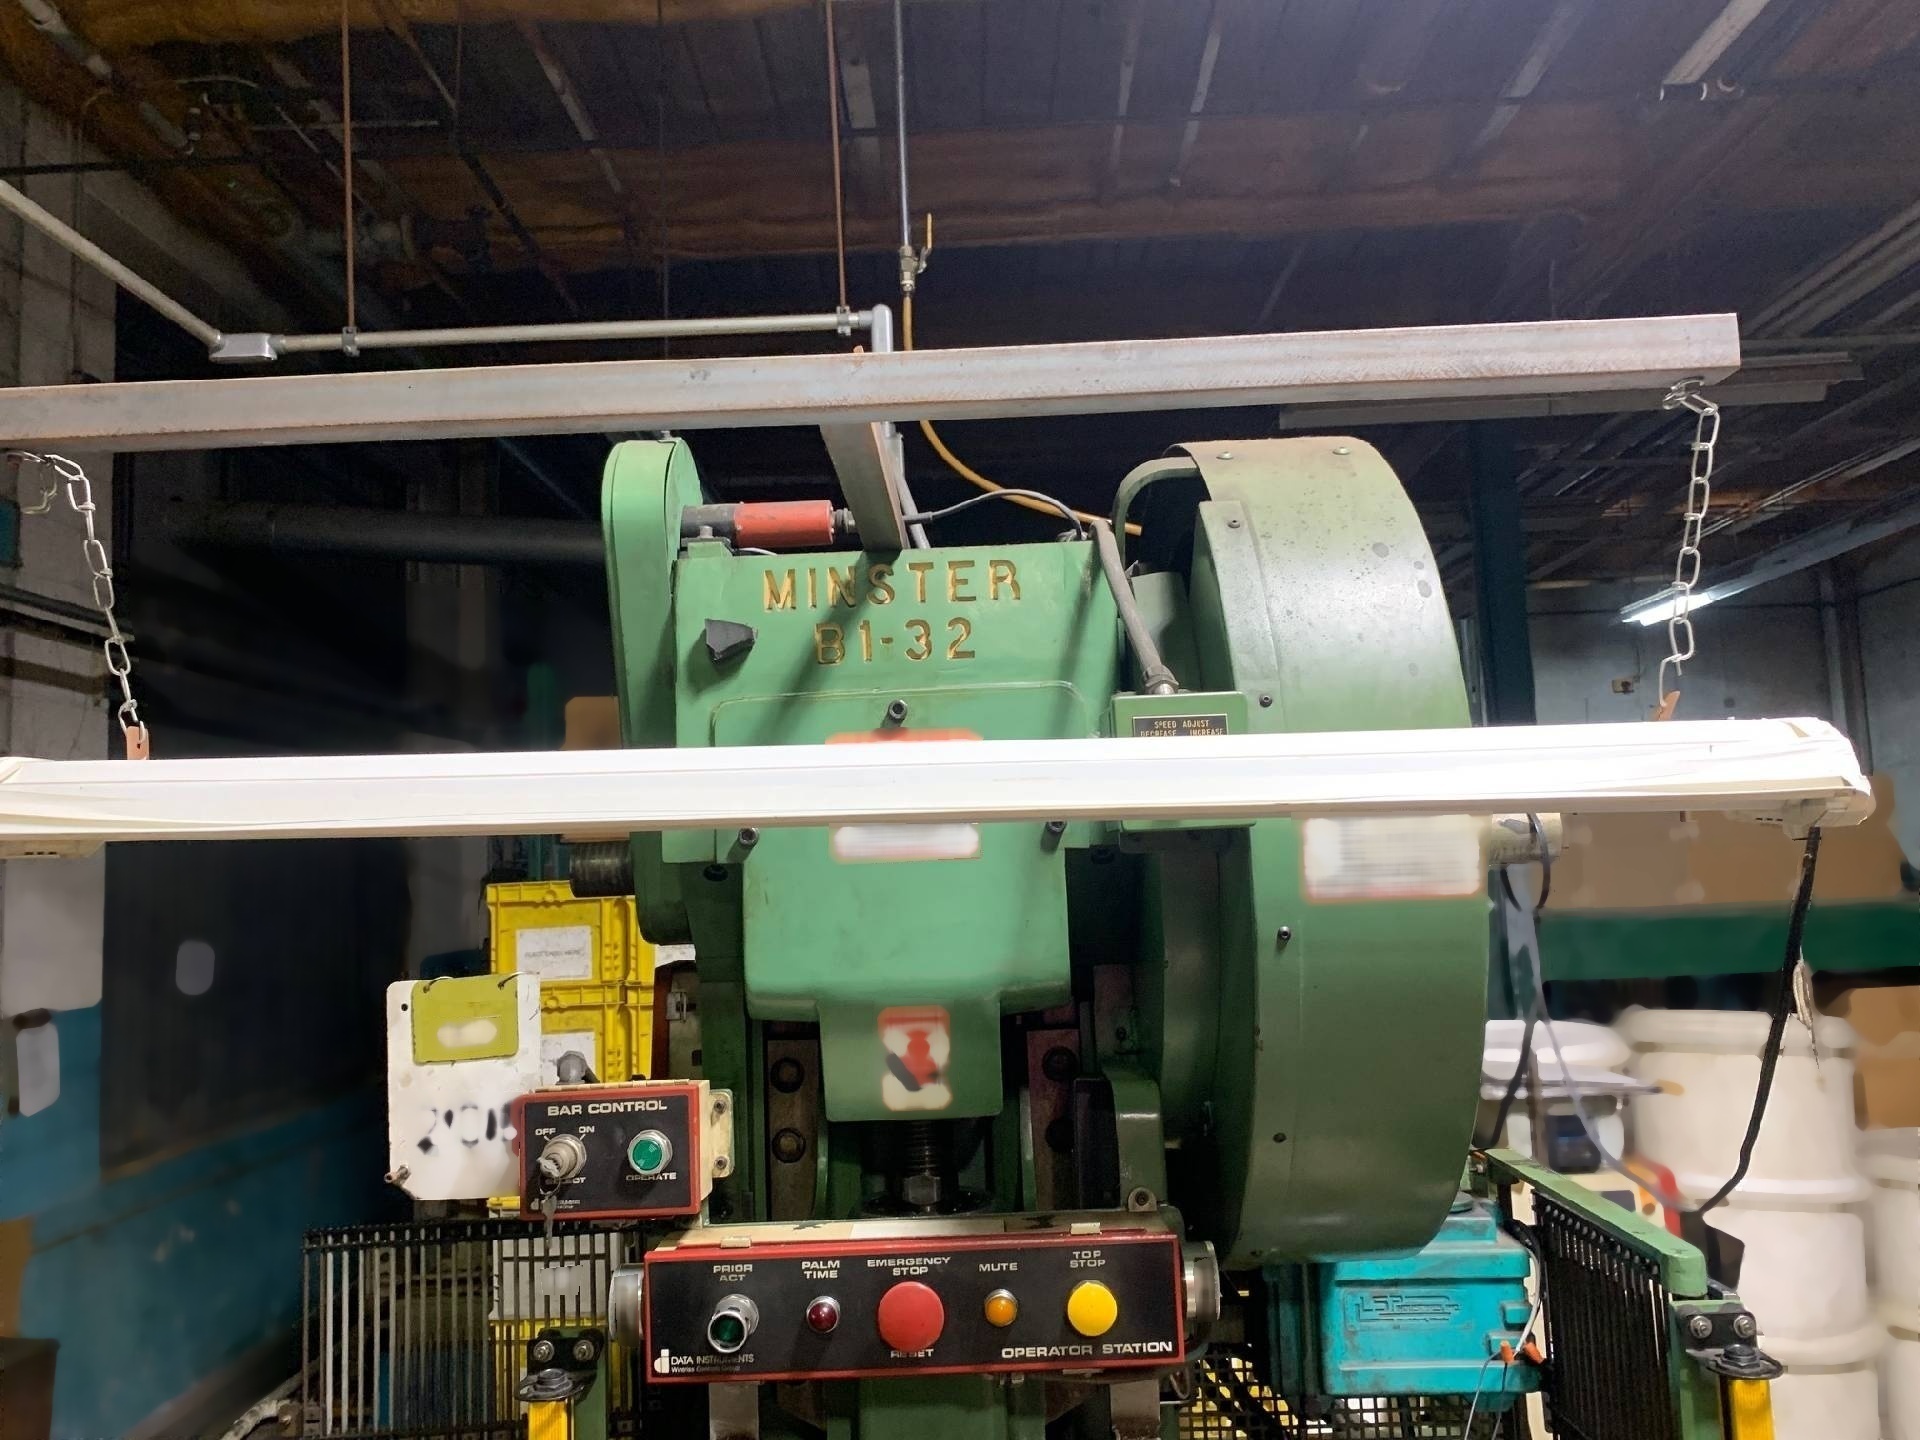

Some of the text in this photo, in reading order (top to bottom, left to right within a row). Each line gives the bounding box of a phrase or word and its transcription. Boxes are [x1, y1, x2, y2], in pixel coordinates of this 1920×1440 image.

[763, 559, 1021, 612] MINSTER
[814, 616, 976, 665] B1-32
[1154, 719, 1210, 729] SPEED ADJUST
[1189, 728, 1224, 736] INCREASE
[547, 1100, 668, 1116] BAR CONTROL
[535, 1127, 556, 1136] OFF
[625, 1172, 677, 1181] OPERATE
[1072, 1250, 1101, 1260] TOP
[801, 1260, 840, 1270] PALM
[867, 1256, 950, 1267] EMERGENCY
[1069, 1259, 1106, 1268] STOP
[713, 1264, 753, 1273] PRIOR
[892, 1266, 929, 1276] STOP
[978, 1262, 1018, 1272] MUTE
[719, 1274, 746, 1282] ACT
[803, 1269, 838, 1279] TIME
[1001, 1341, 1173, 1359] OPERATOR STATION
[671, 1356, 694, 1365] DATA
